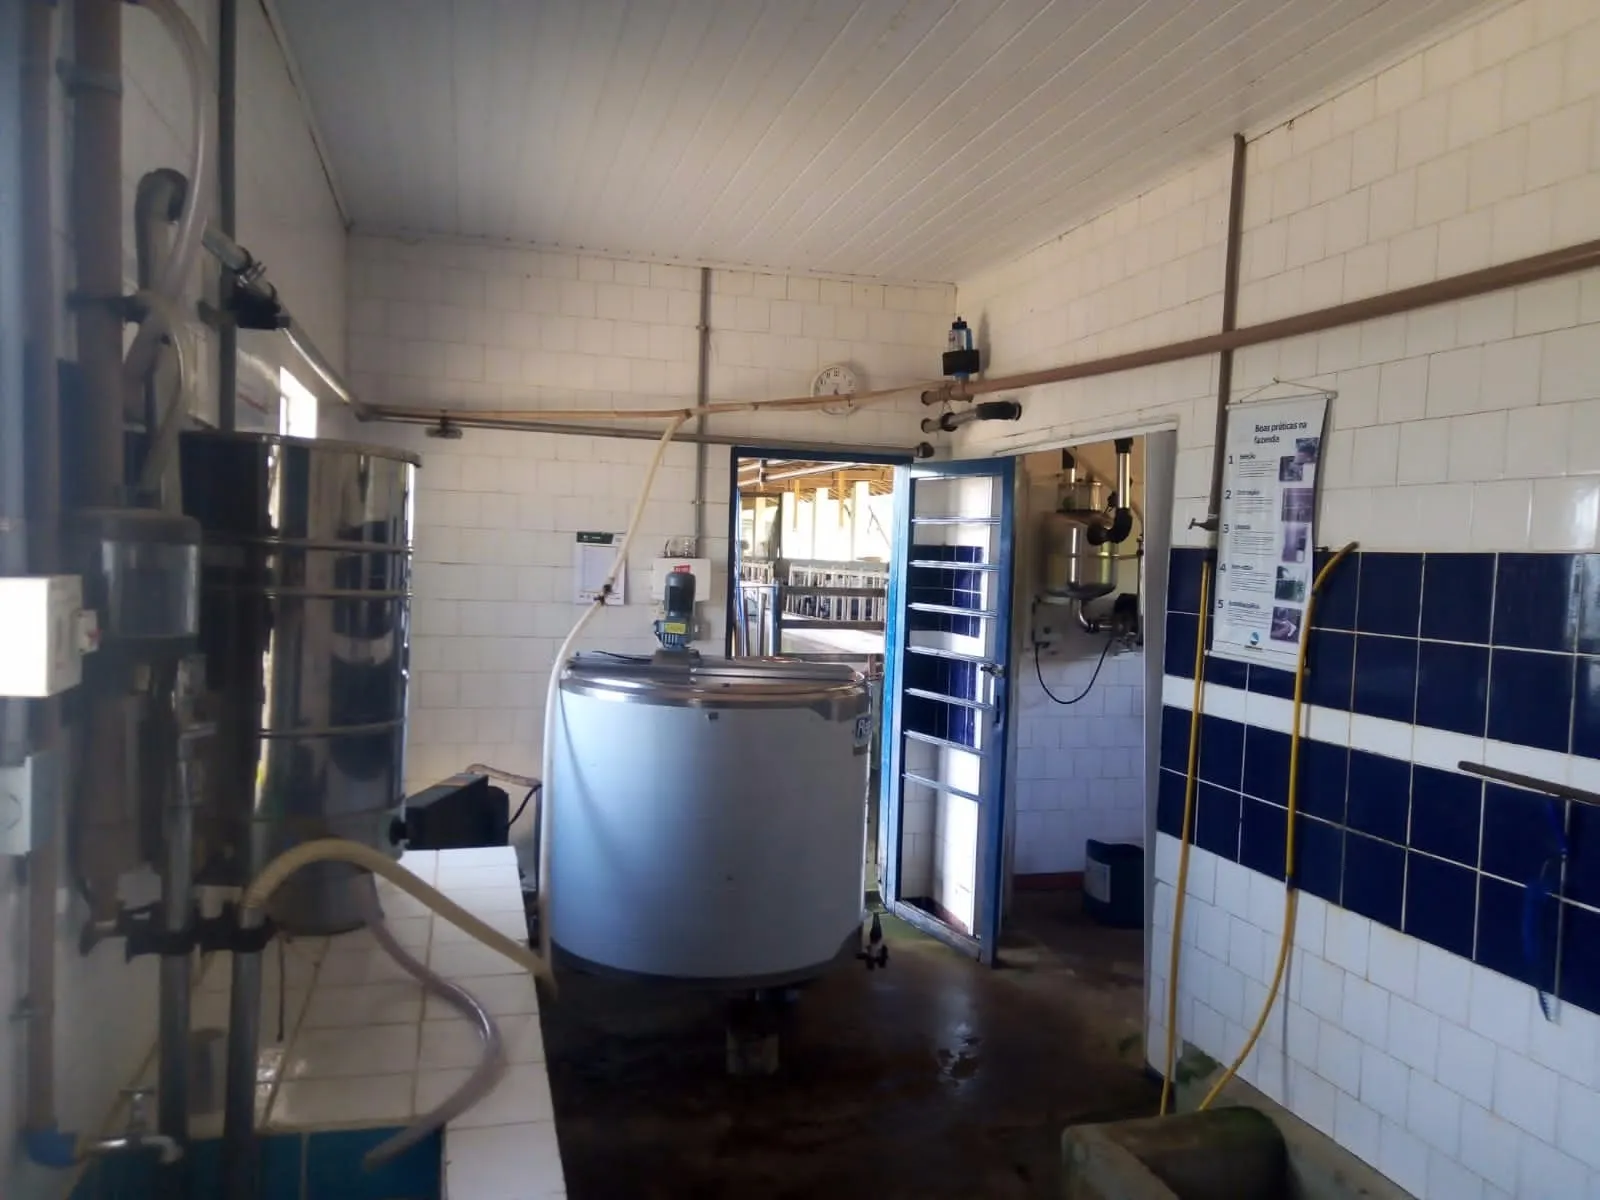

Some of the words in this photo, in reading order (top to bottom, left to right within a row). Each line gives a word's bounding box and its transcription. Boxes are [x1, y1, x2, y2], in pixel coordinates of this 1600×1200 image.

[1255, 424, 1270, 433] Boas
[1271, 422, 1297, 432] práticas
[1254, 434, 1280, 444] fazenda
[1228, 455, 1233, 464] 1
[1225, 490, 1231, 499] 2
[1223, 524, 1229, 533] 3
[1219, 563, 1226, 571] 4
[1217, 599, 1224, 608] 5
